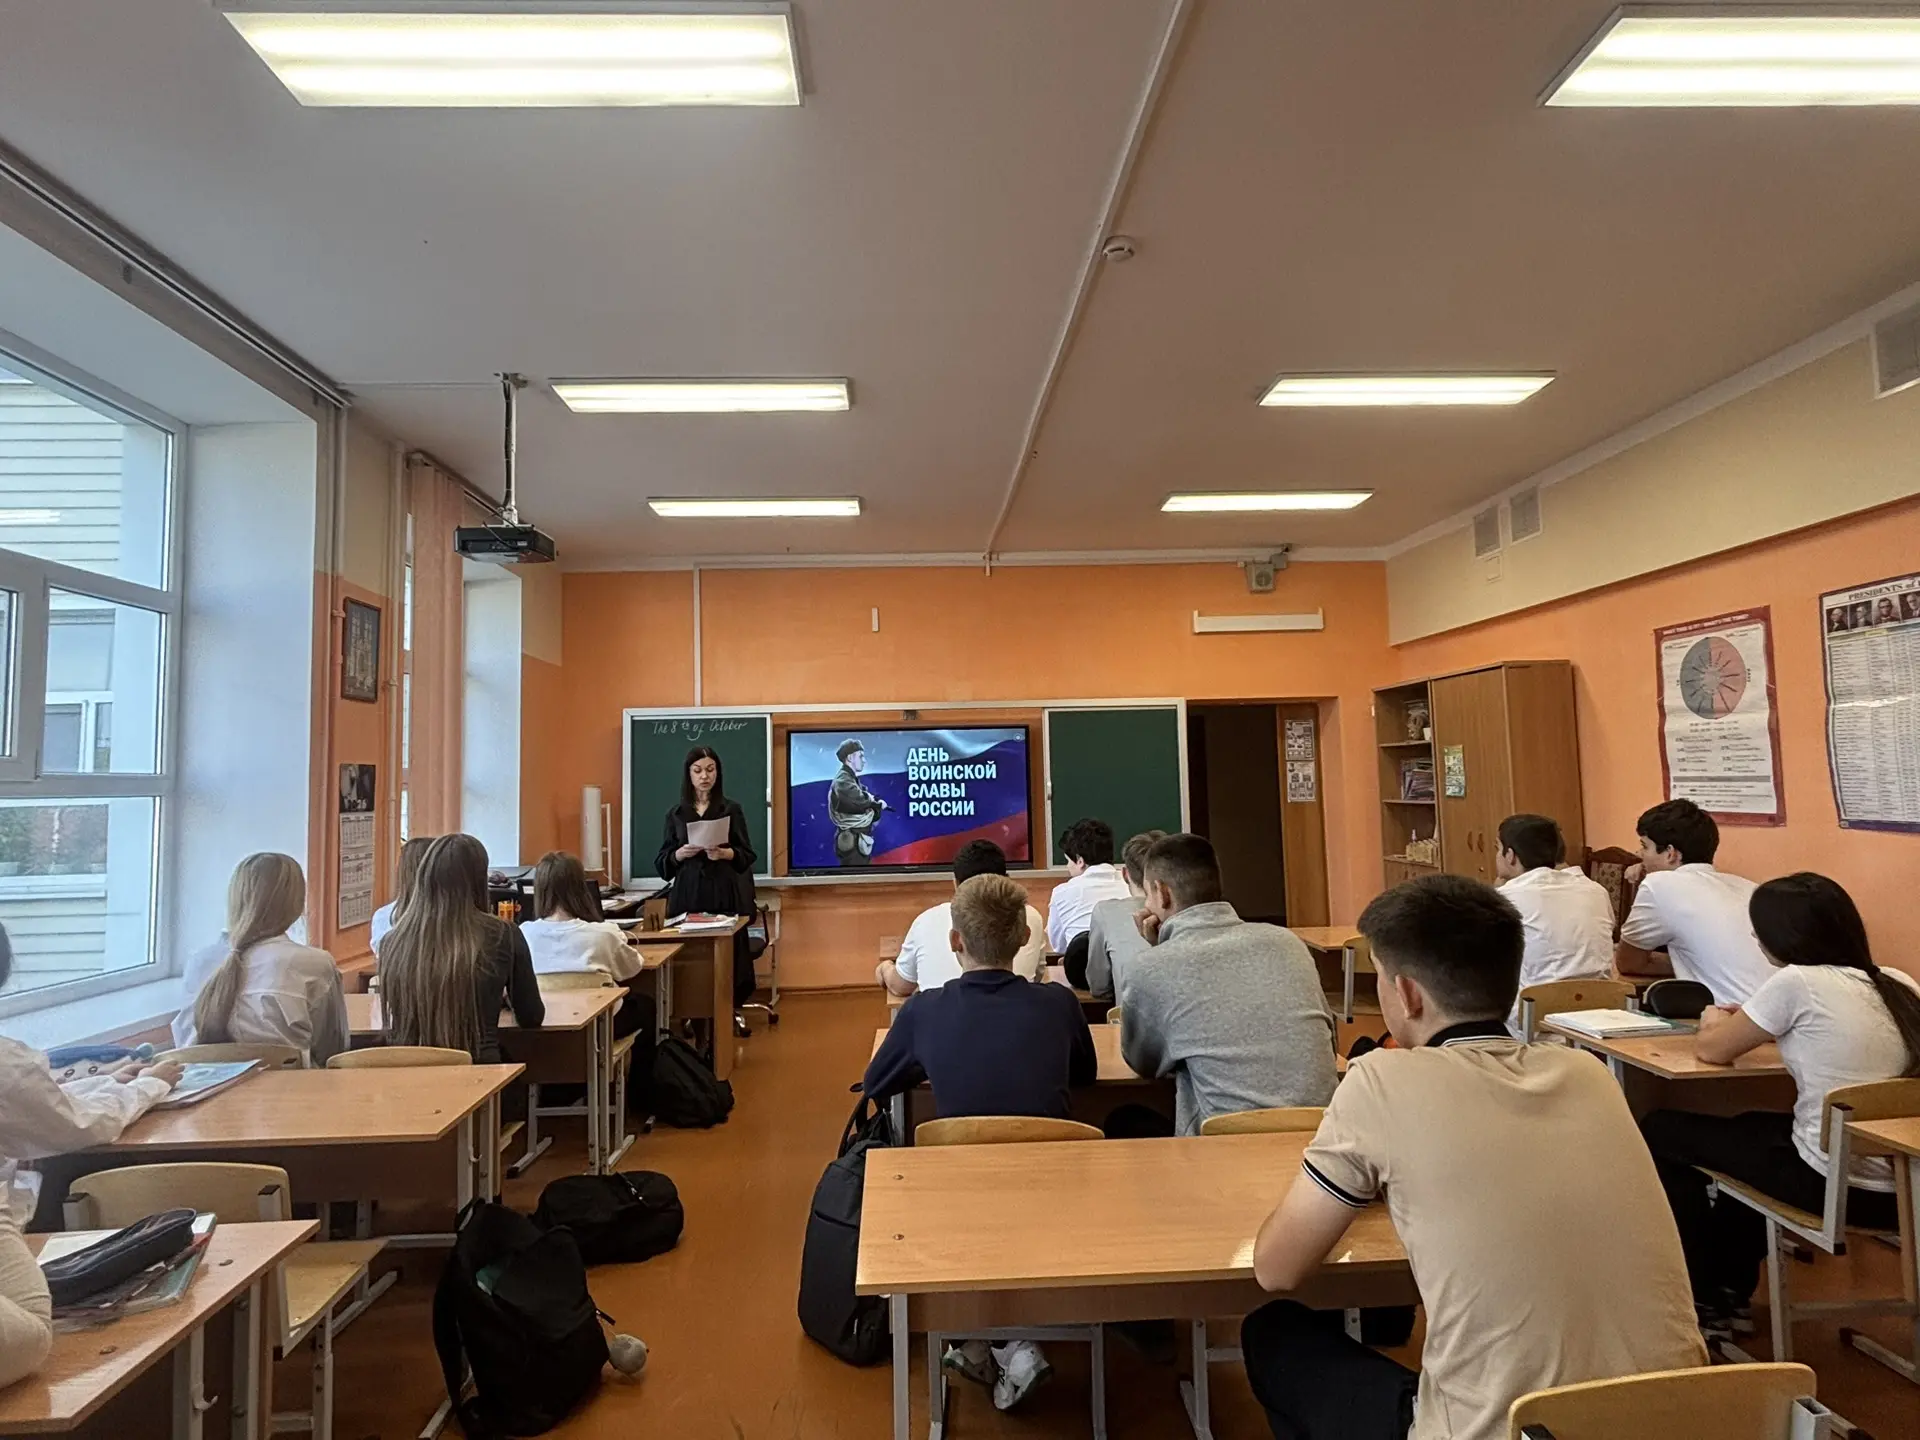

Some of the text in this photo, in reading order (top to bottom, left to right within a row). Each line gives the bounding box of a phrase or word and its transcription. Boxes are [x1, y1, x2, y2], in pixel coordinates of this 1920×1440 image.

[1848, 584, 1903, 600] PRESIDENTS
[652, 721, 668, 734] The
[686, 722, 705, 741] of
[709, 720, 748, 731] October
[906, 748, 949, 765] ДЕНЬ
[908, 761, 996, 781] ВОИНСКОЙ
[908, 783, 965, 799] СЛАВЫ
[908, 801, 975, 817] РОССИИ
